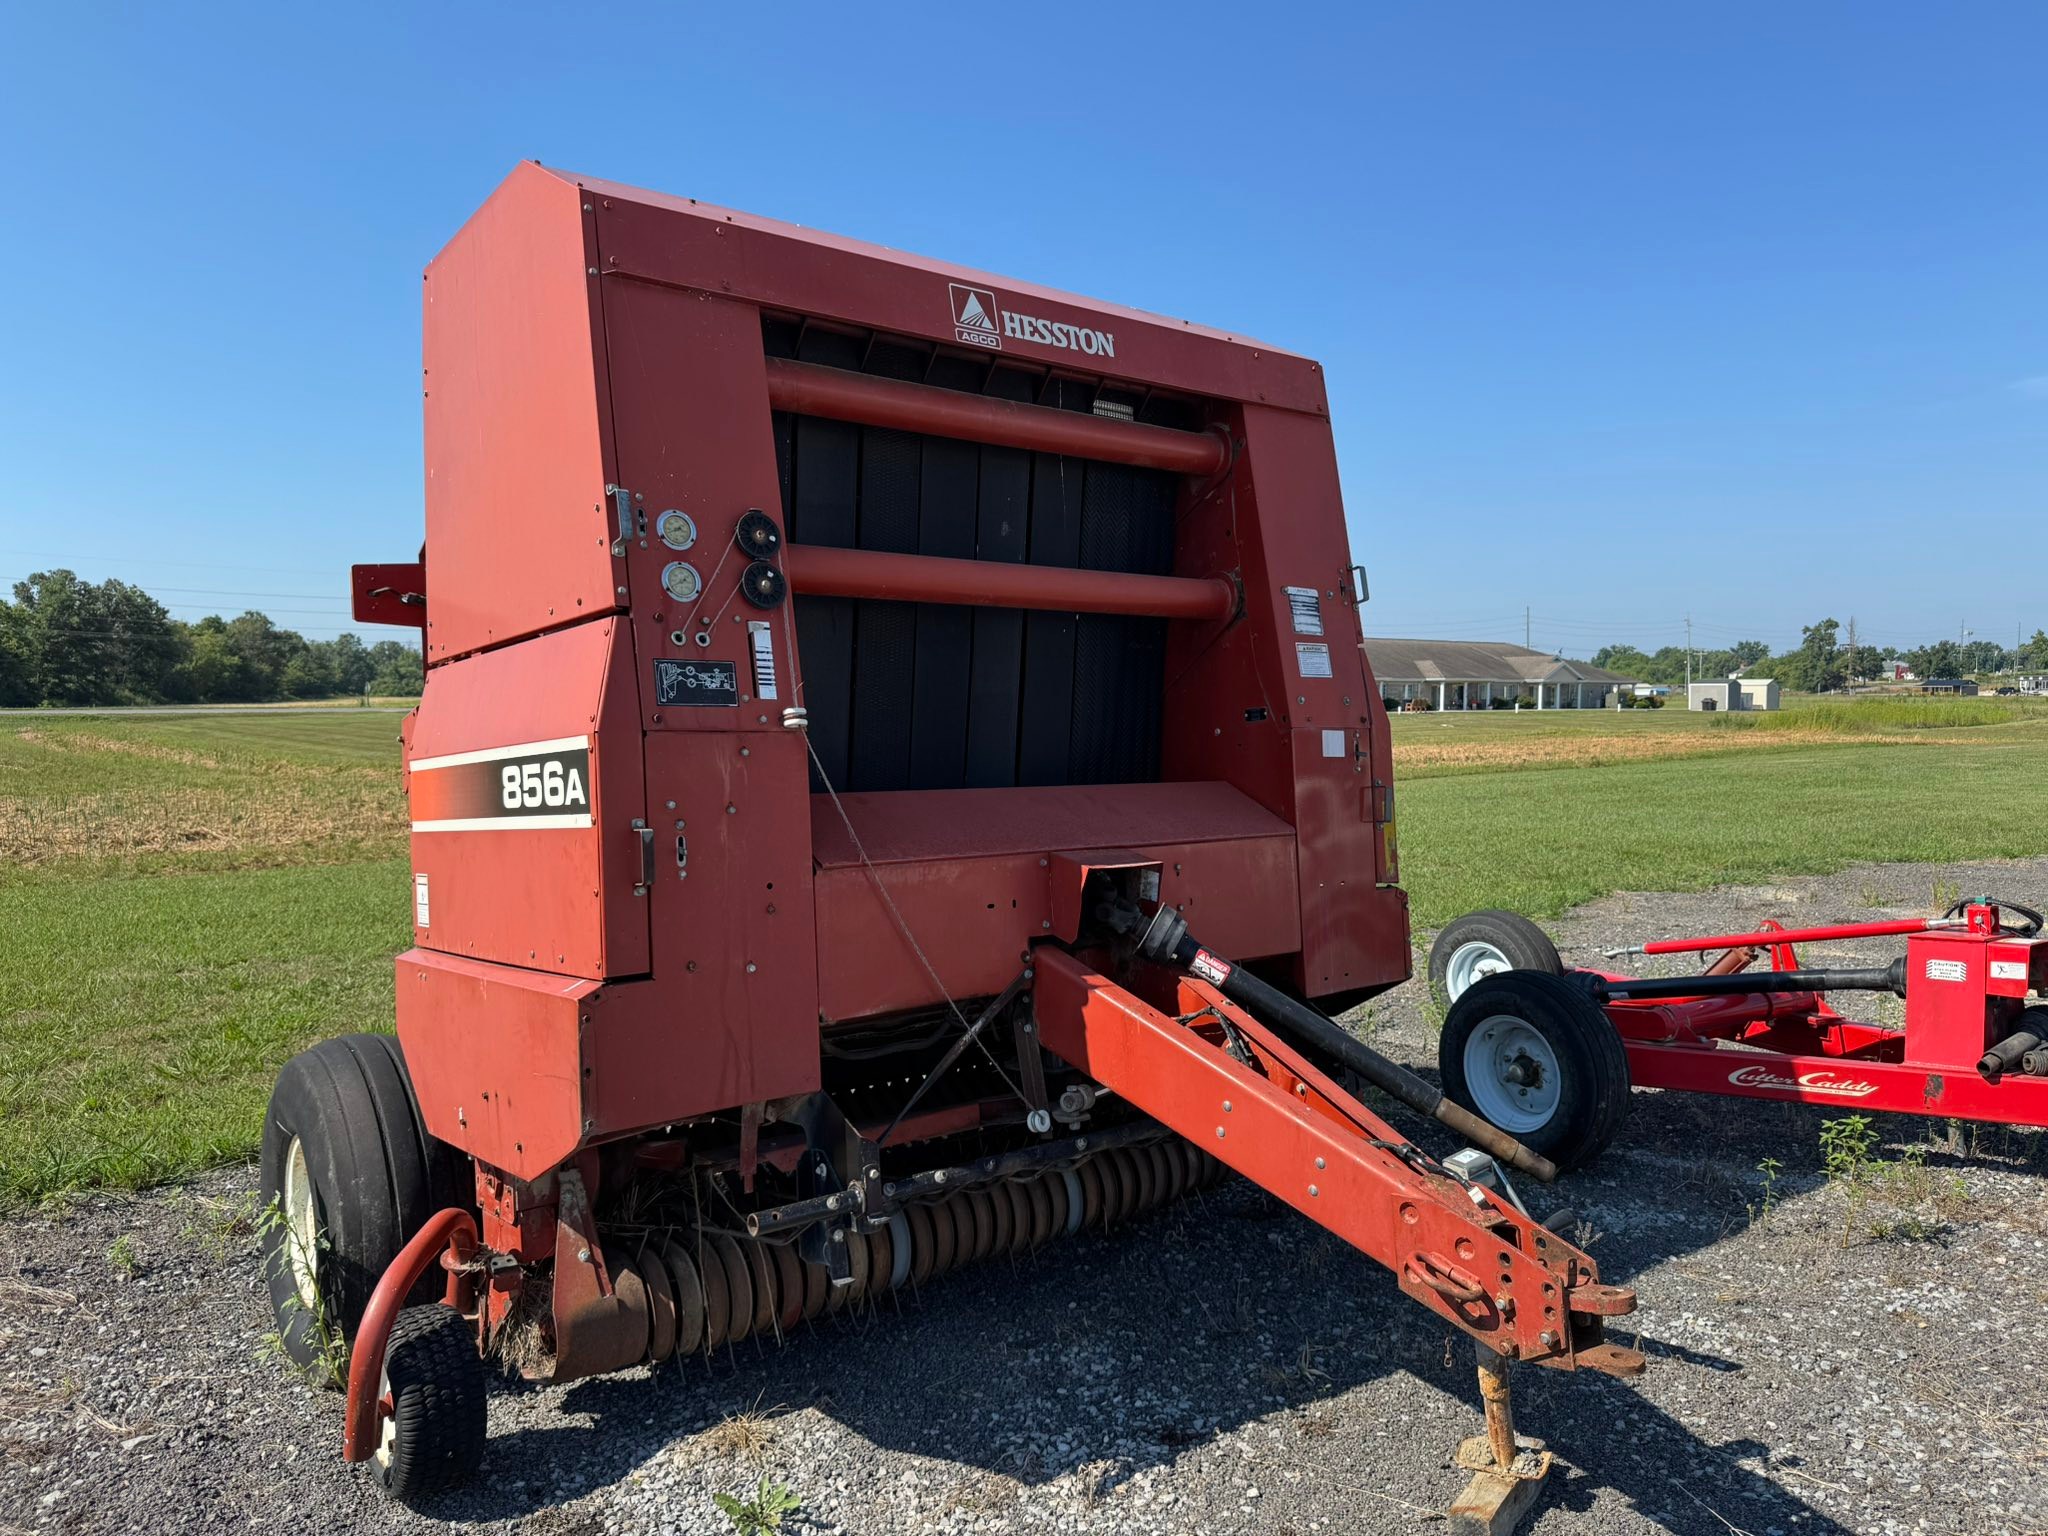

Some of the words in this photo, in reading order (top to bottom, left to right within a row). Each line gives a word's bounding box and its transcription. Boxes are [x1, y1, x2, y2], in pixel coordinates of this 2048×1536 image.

[961, 332, 997, 346] AGCO
[1001, 310, 1115, 357] HESSTON
[502, 761, 586, 809] 856A
[1728, 1065, 1795, 1086] Cutter
[1798, 1072, 1880, 1095] Caddy
